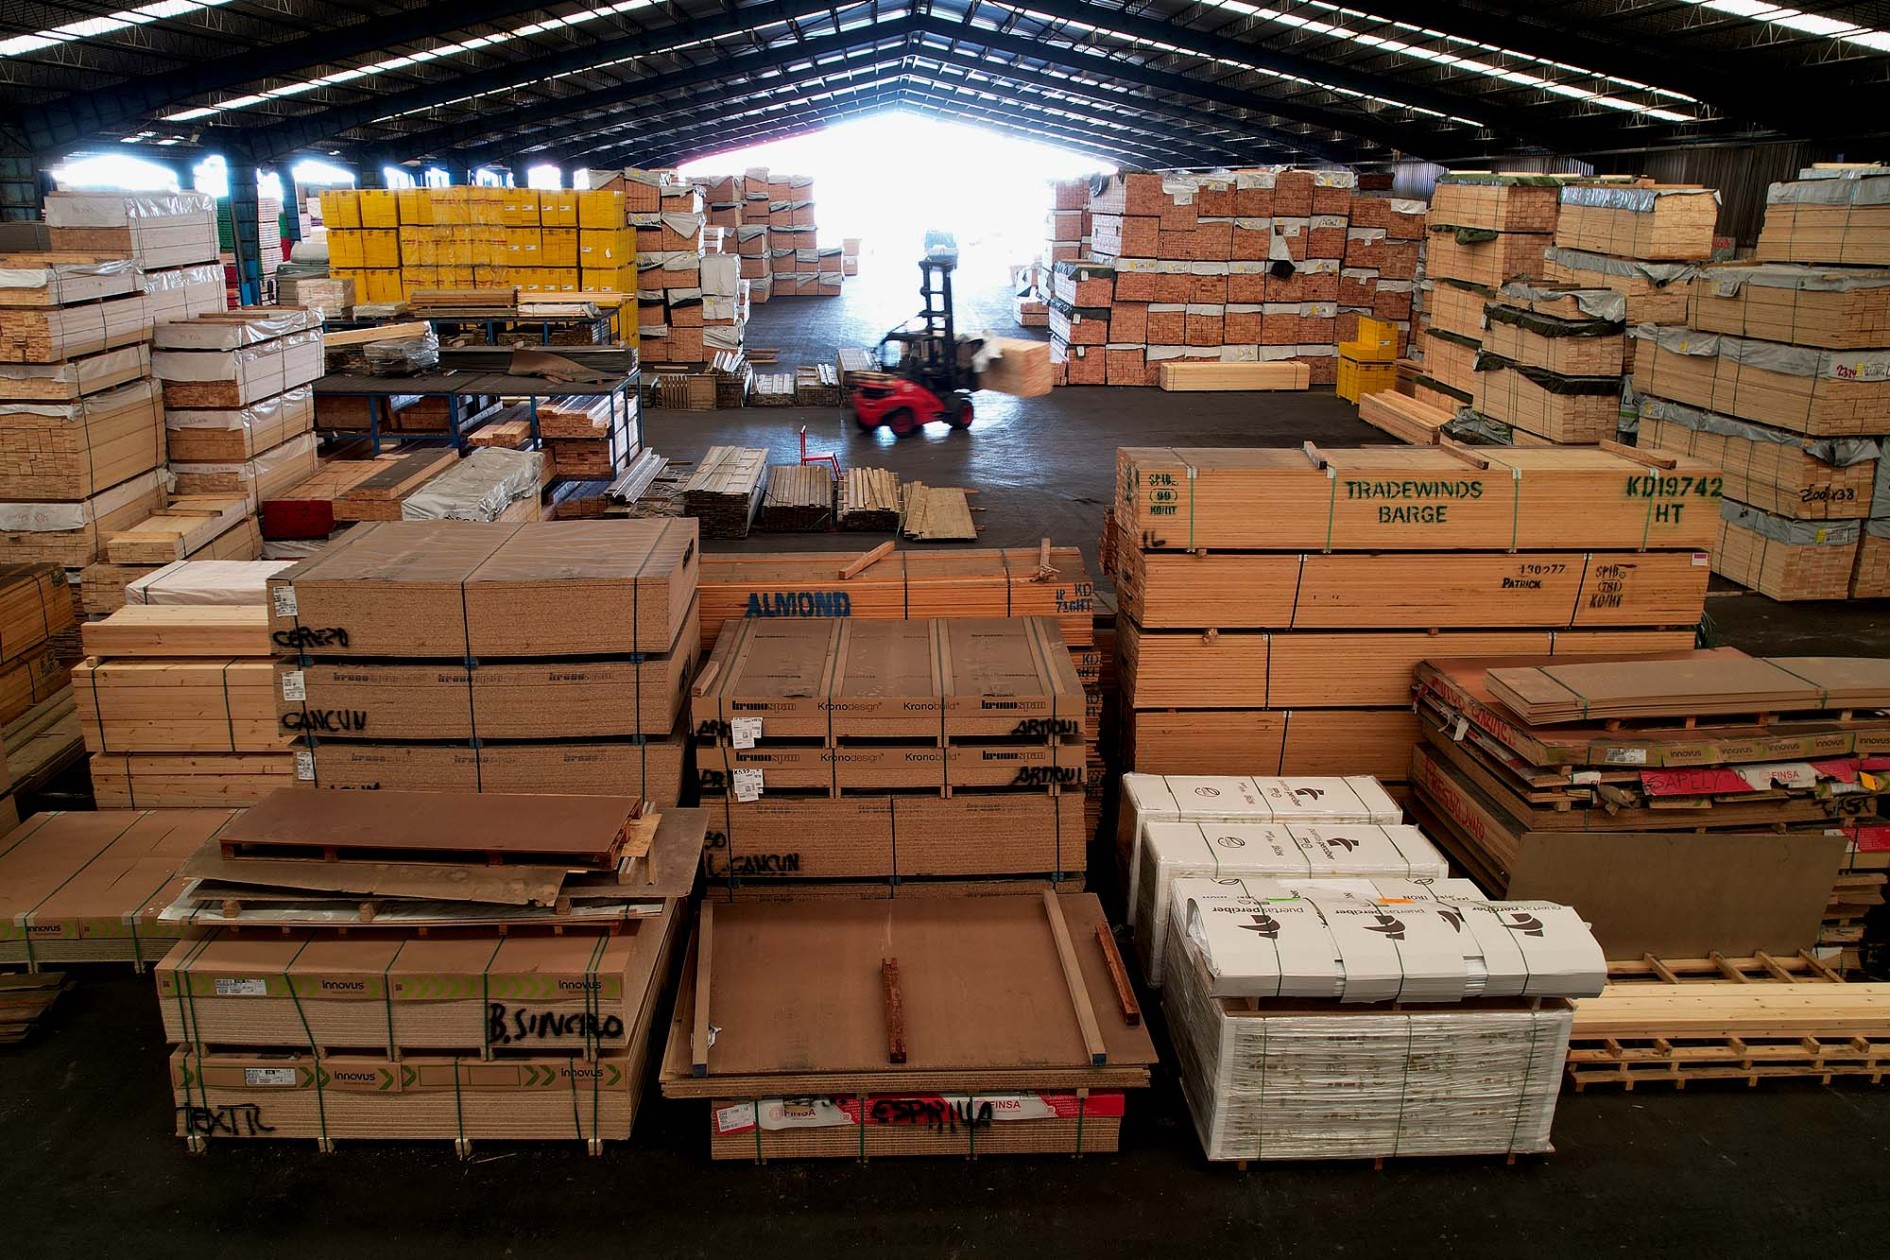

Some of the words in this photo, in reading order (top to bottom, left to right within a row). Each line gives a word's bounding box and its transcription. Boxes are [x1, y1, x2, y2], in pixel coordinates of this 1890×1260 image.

[1344, 481, 1483, 498] TRADEWINDS
[1626, 475, 1723, 496] KD19742
[1379, 505, 1448, 523] BARGE
[1655, 504, 1684, 523] HT
[1502, 577, 1541, 589] PATRICK
[747, 592, 851, 618] ALMOND
[322, 980, 364, 990] innovus
[558, 979, 602, 990] innovus
[334, 1070, 376, 1081] innovus
[561, 1067, 604, 1078] innovus
